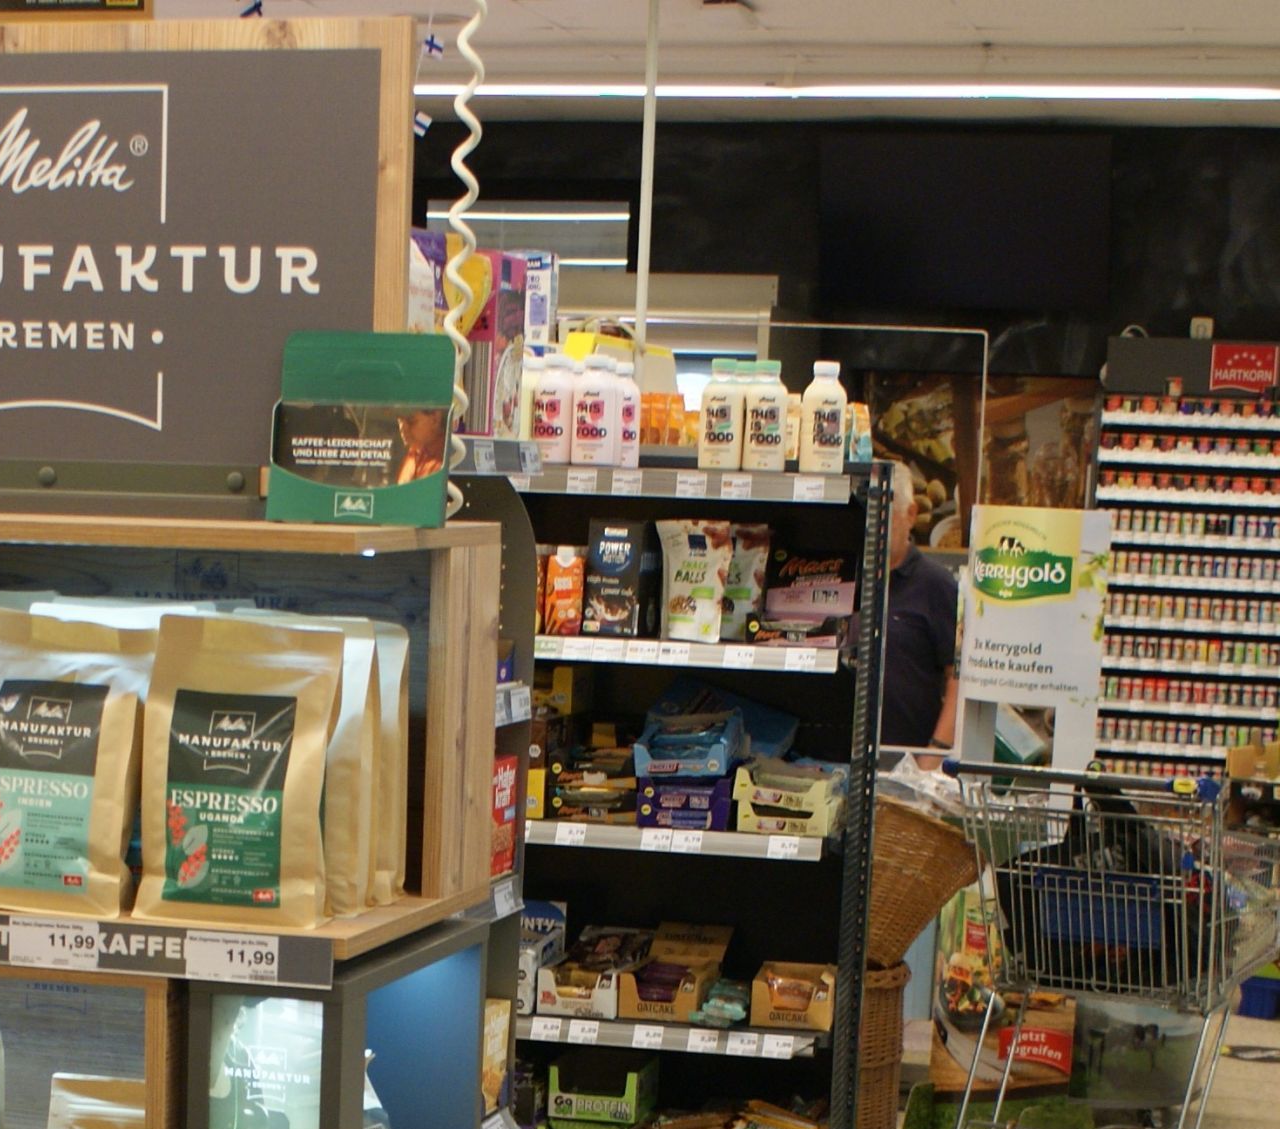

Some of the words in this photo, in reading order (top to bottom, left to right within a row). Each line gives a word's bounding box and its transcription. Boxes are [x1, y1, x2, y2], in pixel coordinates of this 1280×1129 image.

[1215, 368, 1272, 382] HARTKORN
[577, 426, 607, 438] FOOD
[750, 433, 781, 445] FOOD
[292, 437, 392, 449] KAFFEE-LEIDENSCHAFT
[812, 434, 842, 445] FOOD
[293, 449, 312, 457] UND
[314, 449, 338, 458] LIEBE
[339, 449, 360, 459] ZUM
[360, 450, 391, 460] DETAIL
[674, 570, 706, 584] BALLS
[985, 639, 1042, 656] Kerrygold
[1008, 660, 1053, 675] kaufen
[0, 721, 91, 737] MANUFAKTUR
[179, 734, 283, 753] MANUFAKTUR
[171, 789, 278, 814] ESPRESSO
[200, 813, 244, 824] UGANDA
[48, 933, 95, 950] 11,99
[97, 932, 187, 959] KAFFE
[226, 948, 275, 966] 11,99
[637, 1002, 674, 1015] OATCAKE
[225, 1067, 310, 1084] MANUFAKTUR
